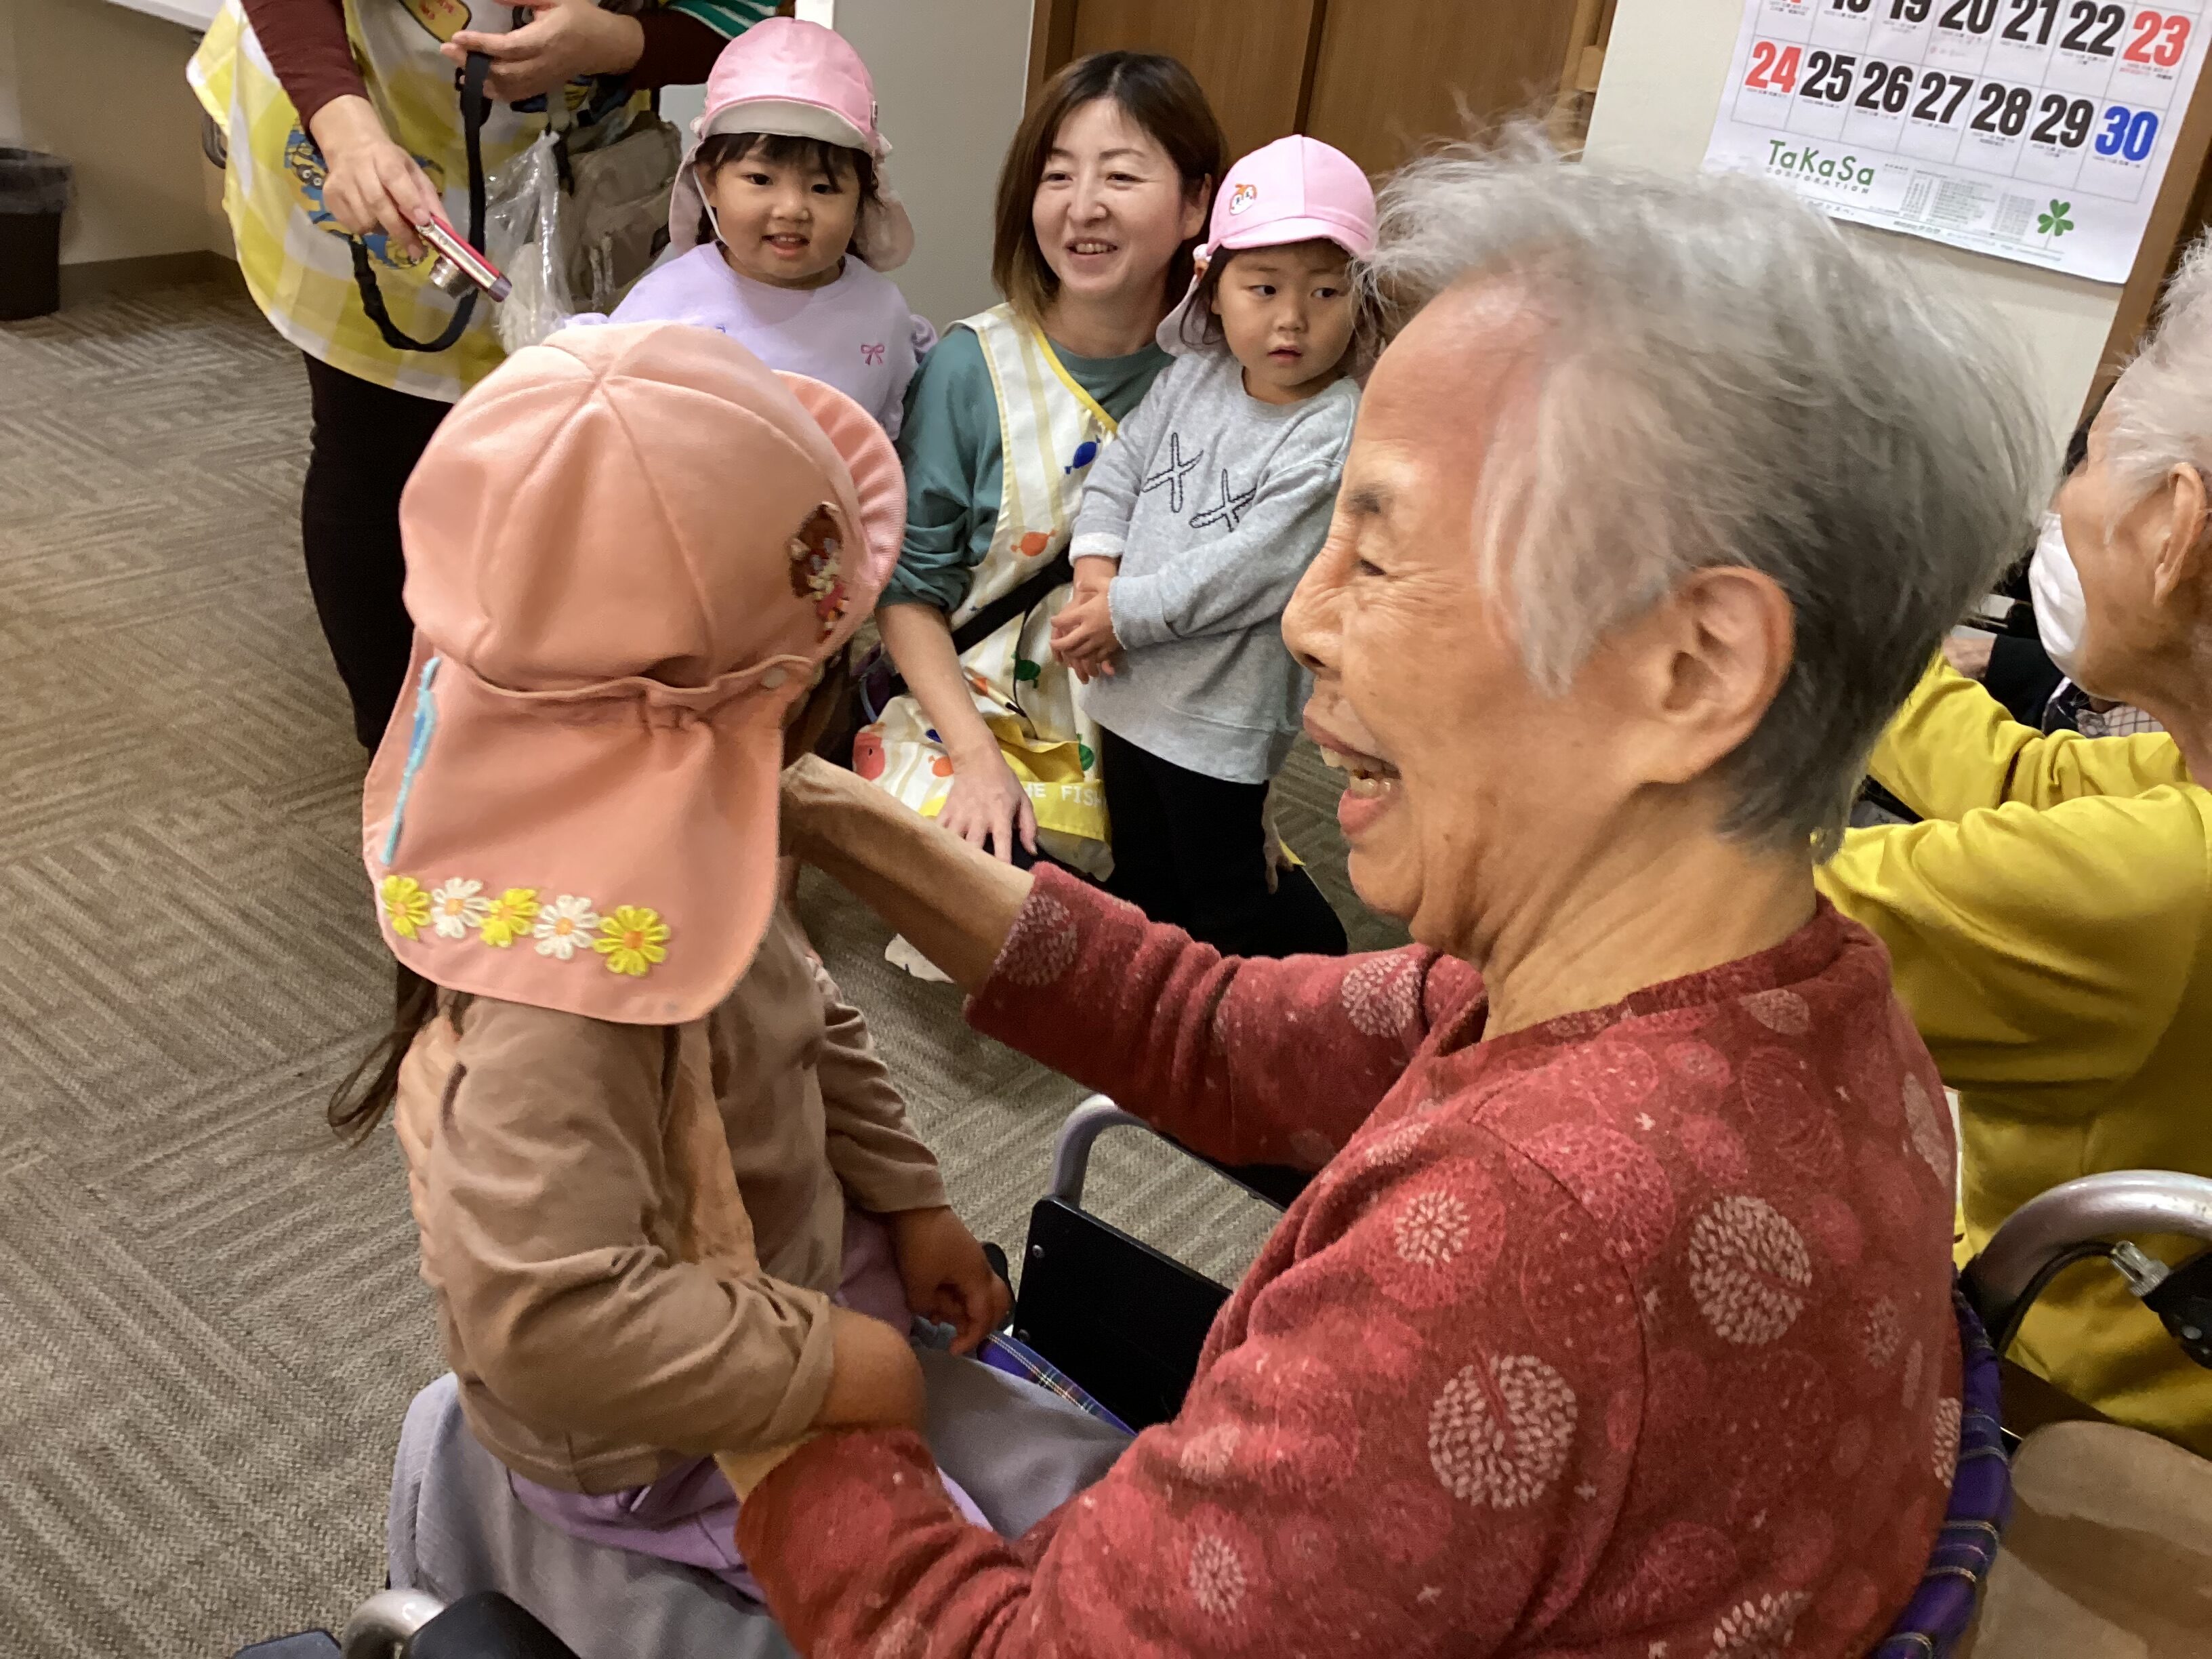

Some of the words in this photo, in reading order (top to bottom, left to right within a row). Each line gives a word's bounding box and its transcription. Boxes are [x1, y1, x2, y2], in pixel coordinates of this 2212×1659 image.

[1938, 0, 1999, 34] 20
[2002, 0, 2060, 45] 21
[2060, 0, 2125, 56] 22
[2123, 11, 2190, 66] 23
[1745, 41, 1801, 92] 24
[1799, 51, 1856, 102] 25
[1855, 62, 1913, 112] 26
[1912, 72, 1973, 123] 27
[1970, 82, 2032, 136] 28
[2030, 94, 2093, 148] 29
[2095, 106, 2158, 161] 30
[1765, 167, 1869, 194] CORPORATION
[1769, 140, 1875, 186] TaKaSa
